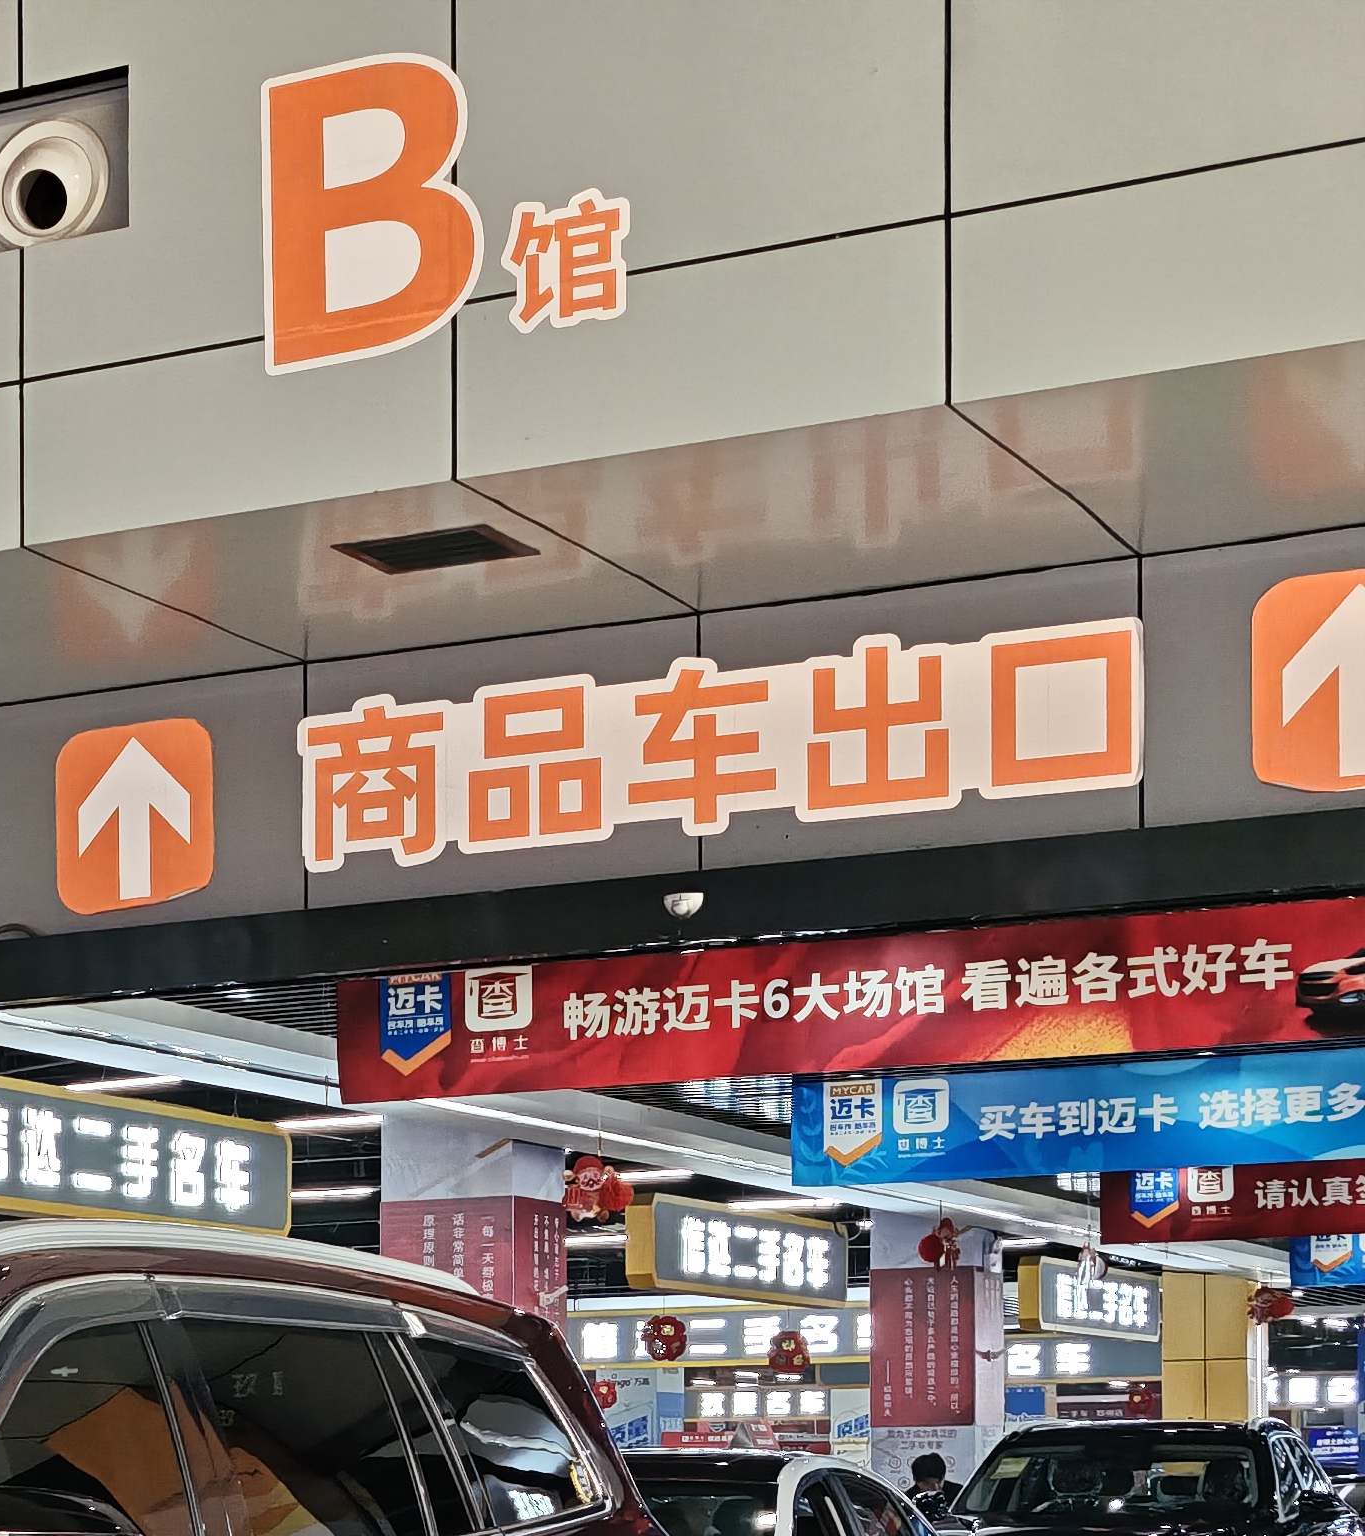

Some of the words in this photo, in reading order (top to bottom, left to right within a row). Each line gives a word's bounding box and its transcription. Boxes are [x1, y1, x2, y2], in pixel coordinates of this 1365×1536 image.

[303, 620, 1141, 872] 商品车出口
[388, 985, 443, 1016] 迈卡
[562, 963, 945, 1041] 畅游迈卡6大场馆
[961, 938, 1295, 1011] 看遍各式好车
[470, 1035, 529, 1054] 查博士
[832, 1084, 874, 1096] MYCAR
[830, 1097, 875, 1120] 迈卡
[978, 1093, 1178, 1142] 买车到迈卡
[1198, 1082, 1365, 1131] 选择更多
[1135, 1171, 1174, 1192] 迈卡
